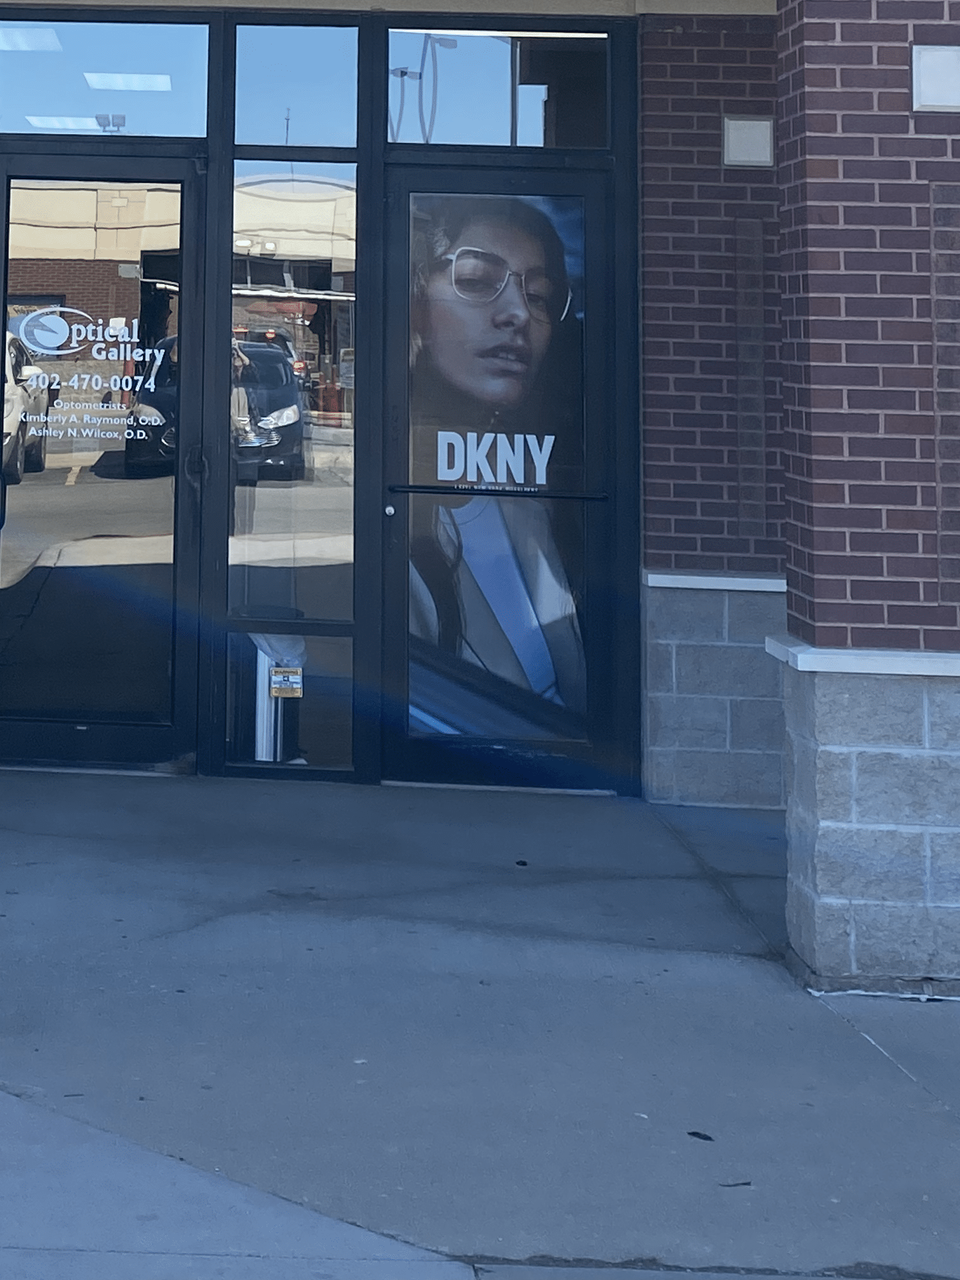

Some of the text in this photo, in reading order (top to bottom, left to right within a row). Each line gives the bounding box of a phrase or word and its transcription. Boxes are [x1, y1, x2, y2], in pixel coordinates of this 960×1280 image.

[19, 306, 140, 355] Optical
[92, 343, 166, 365] Gallery
[26, 373, 156, 393] 402-470-0074
[53, 399, 127, 411] Optometrists
[19, 412, 68, 425] Kimberly
[83, 415, 137, 427] Raymond,
[28, 427, 65, 439] Ashley
[124, 430, 148, 440] O.D.
[437, 430, 556, 485] DKNY
